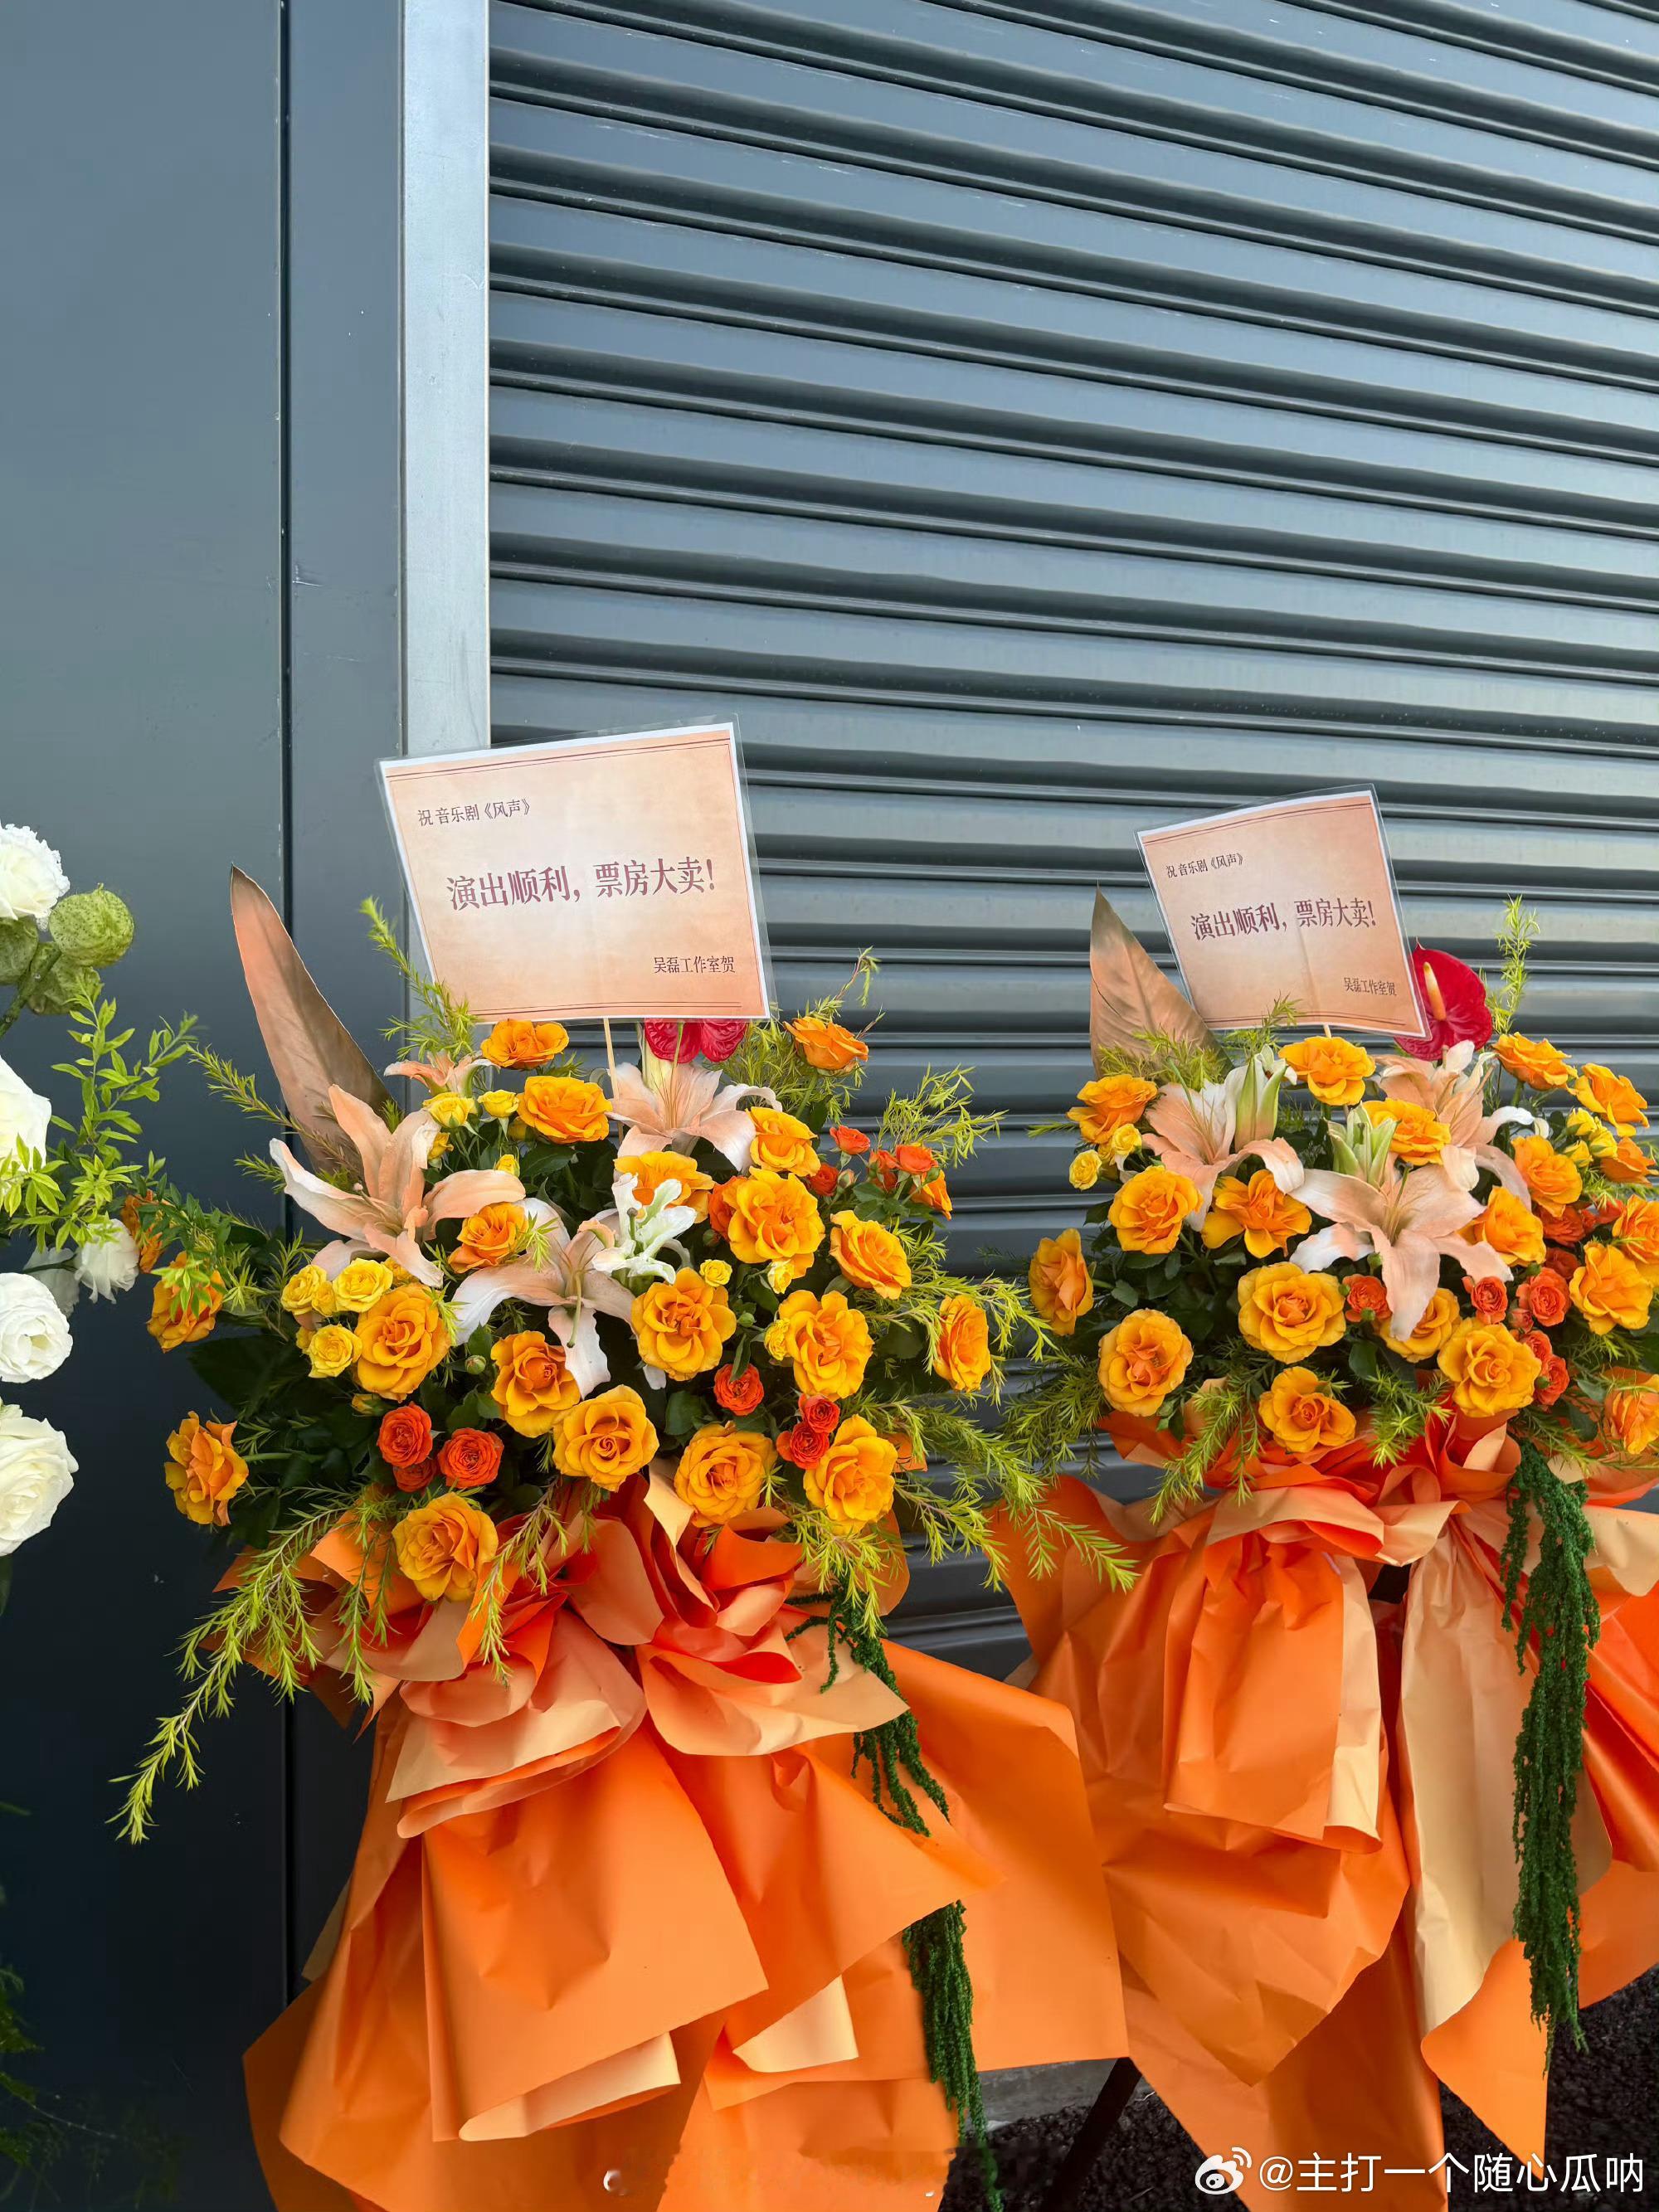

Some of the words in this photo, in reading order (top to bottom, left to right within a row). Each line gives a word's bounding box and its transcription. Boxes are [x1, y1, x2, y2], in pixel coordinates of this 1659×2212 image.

[653, 955, 736, 975] 吴磊工作室贺
[1343, 976, 1397, 996] 吴磊工作室贺
